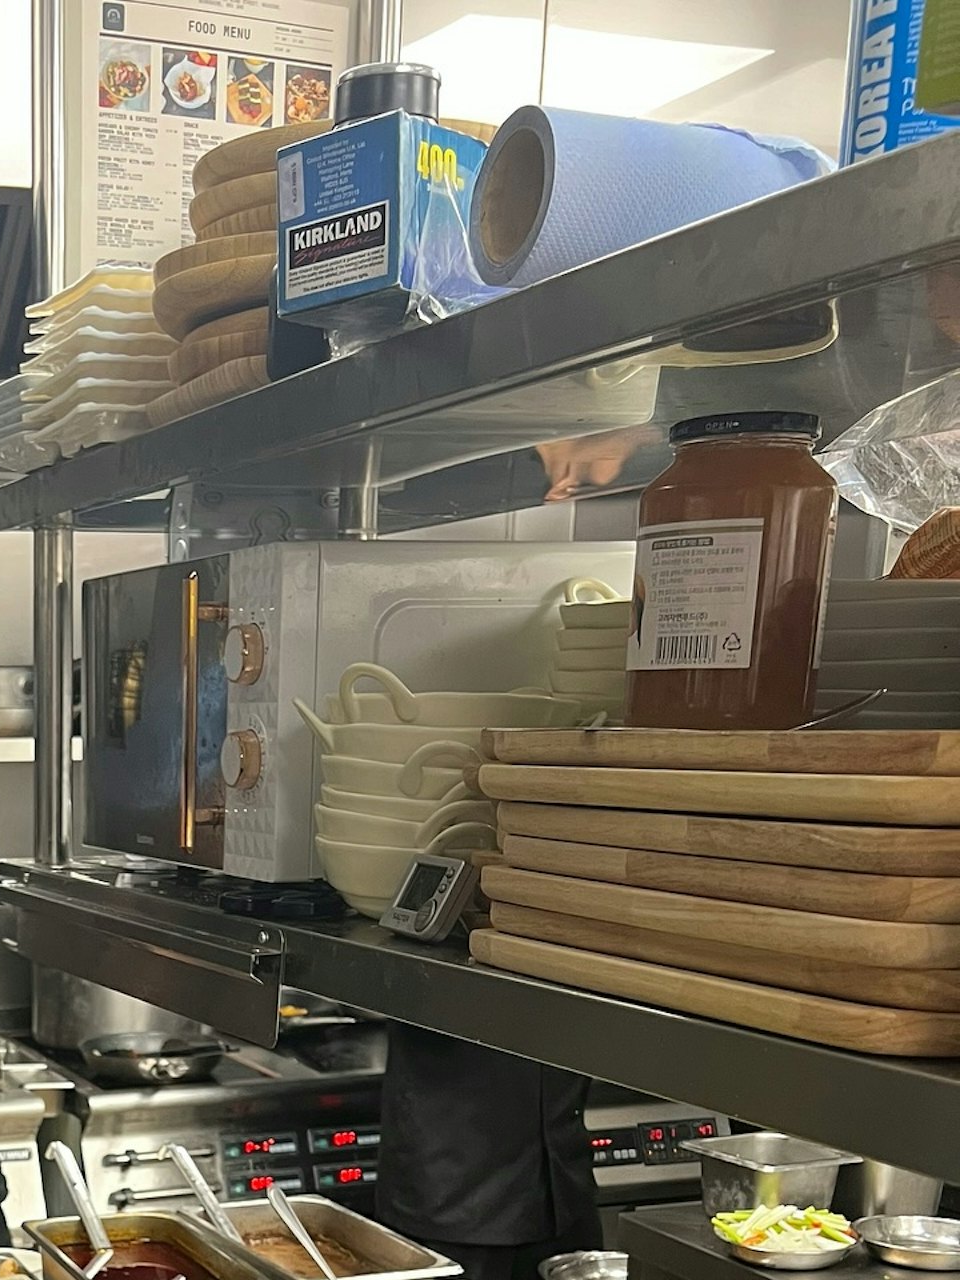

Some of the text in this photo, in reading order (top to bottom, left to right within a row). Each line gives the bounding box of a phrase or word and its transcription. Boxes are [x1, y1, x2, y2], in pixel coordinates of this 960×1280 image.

[188, 20, 251, 40] FOOD MENU
[294, 210, 382, 252] KIRKLAND
[705, 420, 732, 431] OPEN
